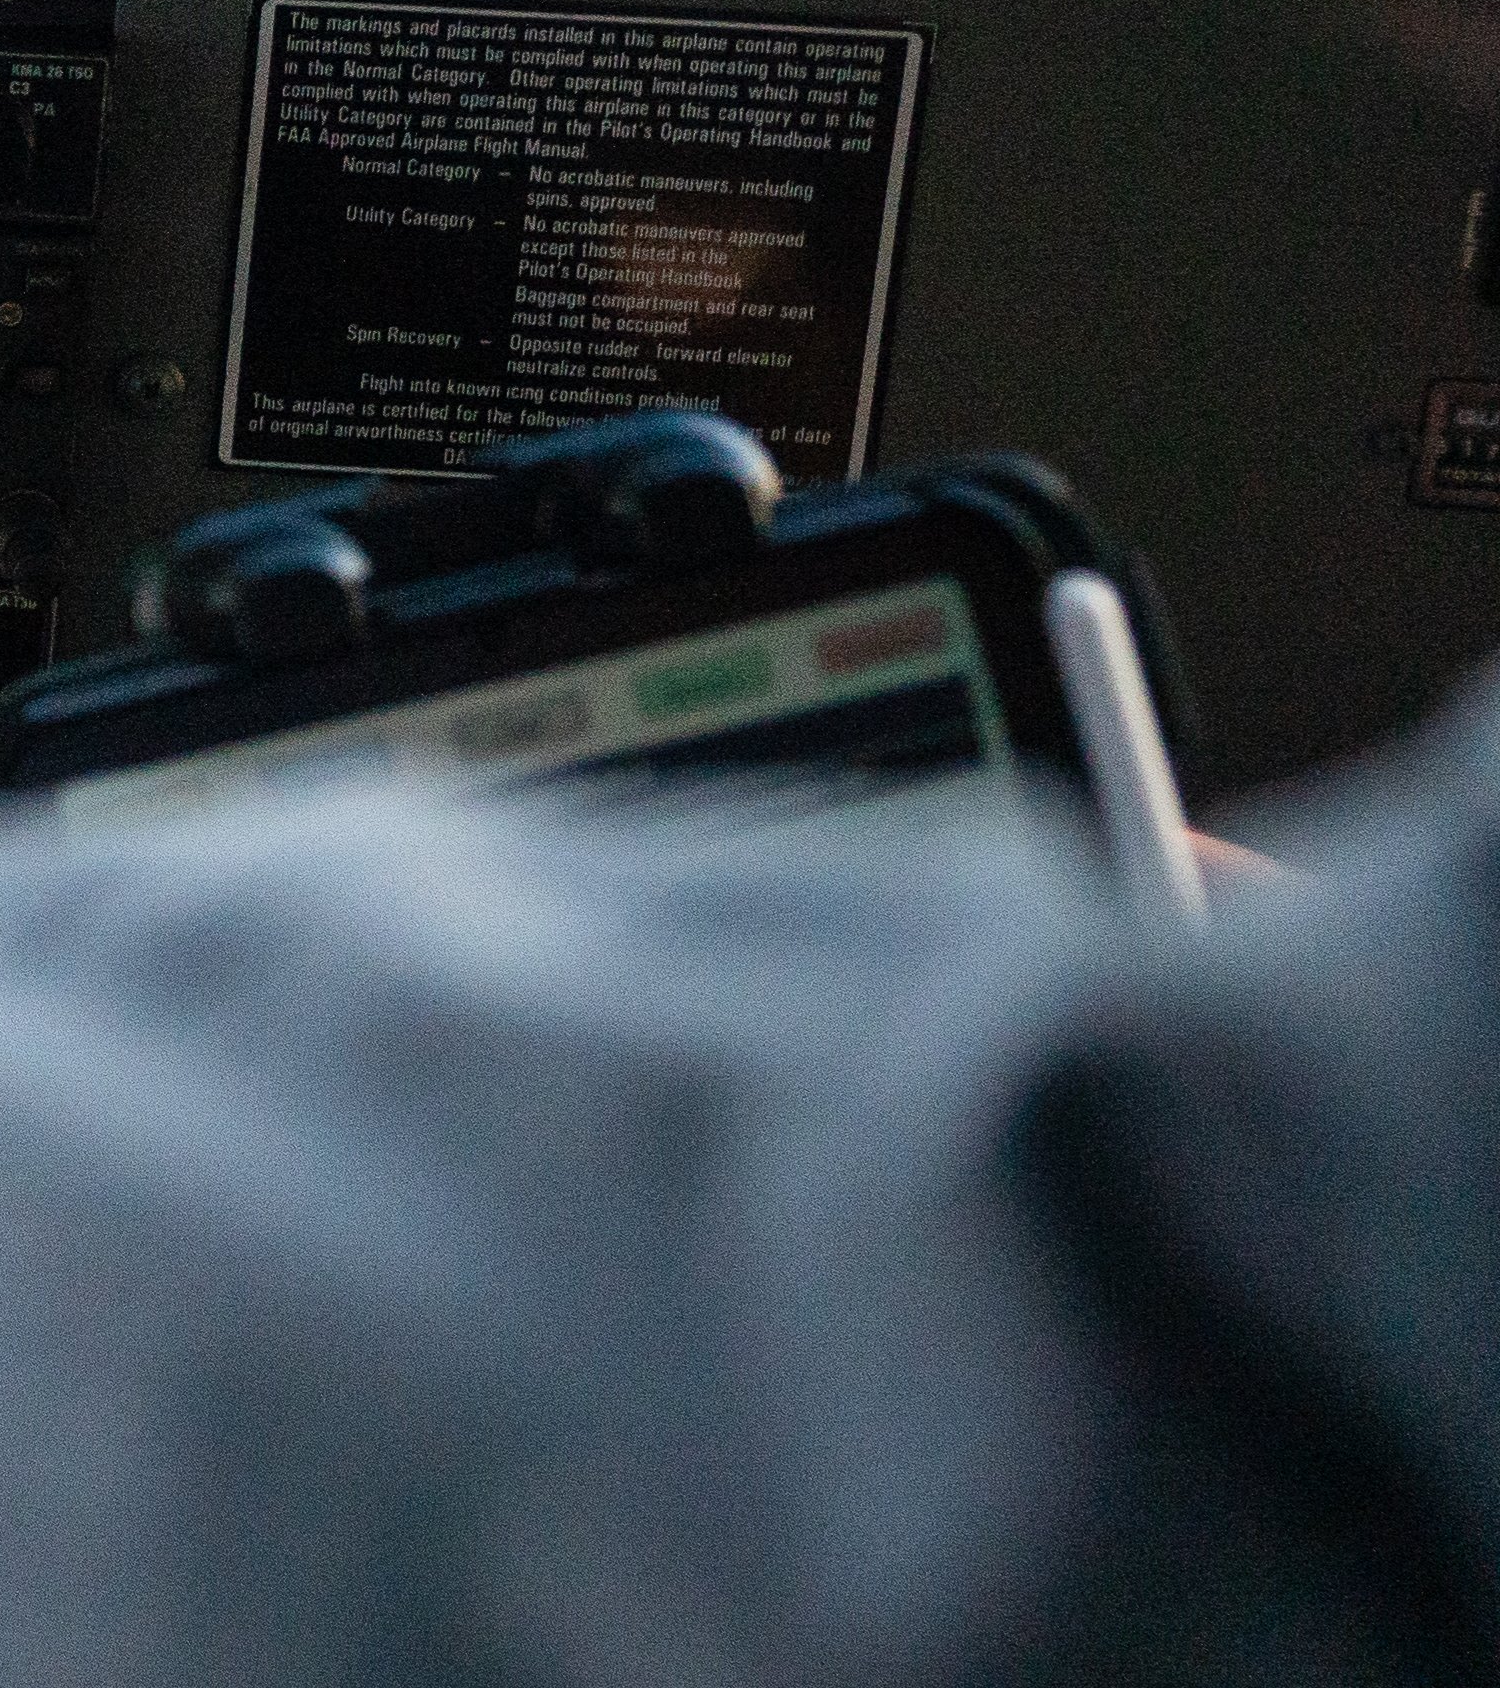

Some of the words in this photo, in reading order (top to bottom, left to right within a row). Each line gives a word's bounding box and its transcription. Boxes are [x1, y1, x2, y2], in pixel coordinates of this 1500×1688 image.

[290, 12, 318, 31] The
[326, 14, 401, 36] markings
[409, 20, 440, 37] and
[446, 20, 516, 42] placards
[524, 24, 594, 45] installed
[601, 30, 616, 47] in
[624, 30, 655, 48] this
[662, 33, 728, 54] airplane
[735, 36, 798, 54] contain
[806, 41, 886, 64] operating
[10, 80, 31, 96] C3
[277, 126, 311, 144] FAA
[318, 128, 396, 150] Approved
[400, 132, 468, 154] Airplane
[474, 135, 518, 158] Flight
